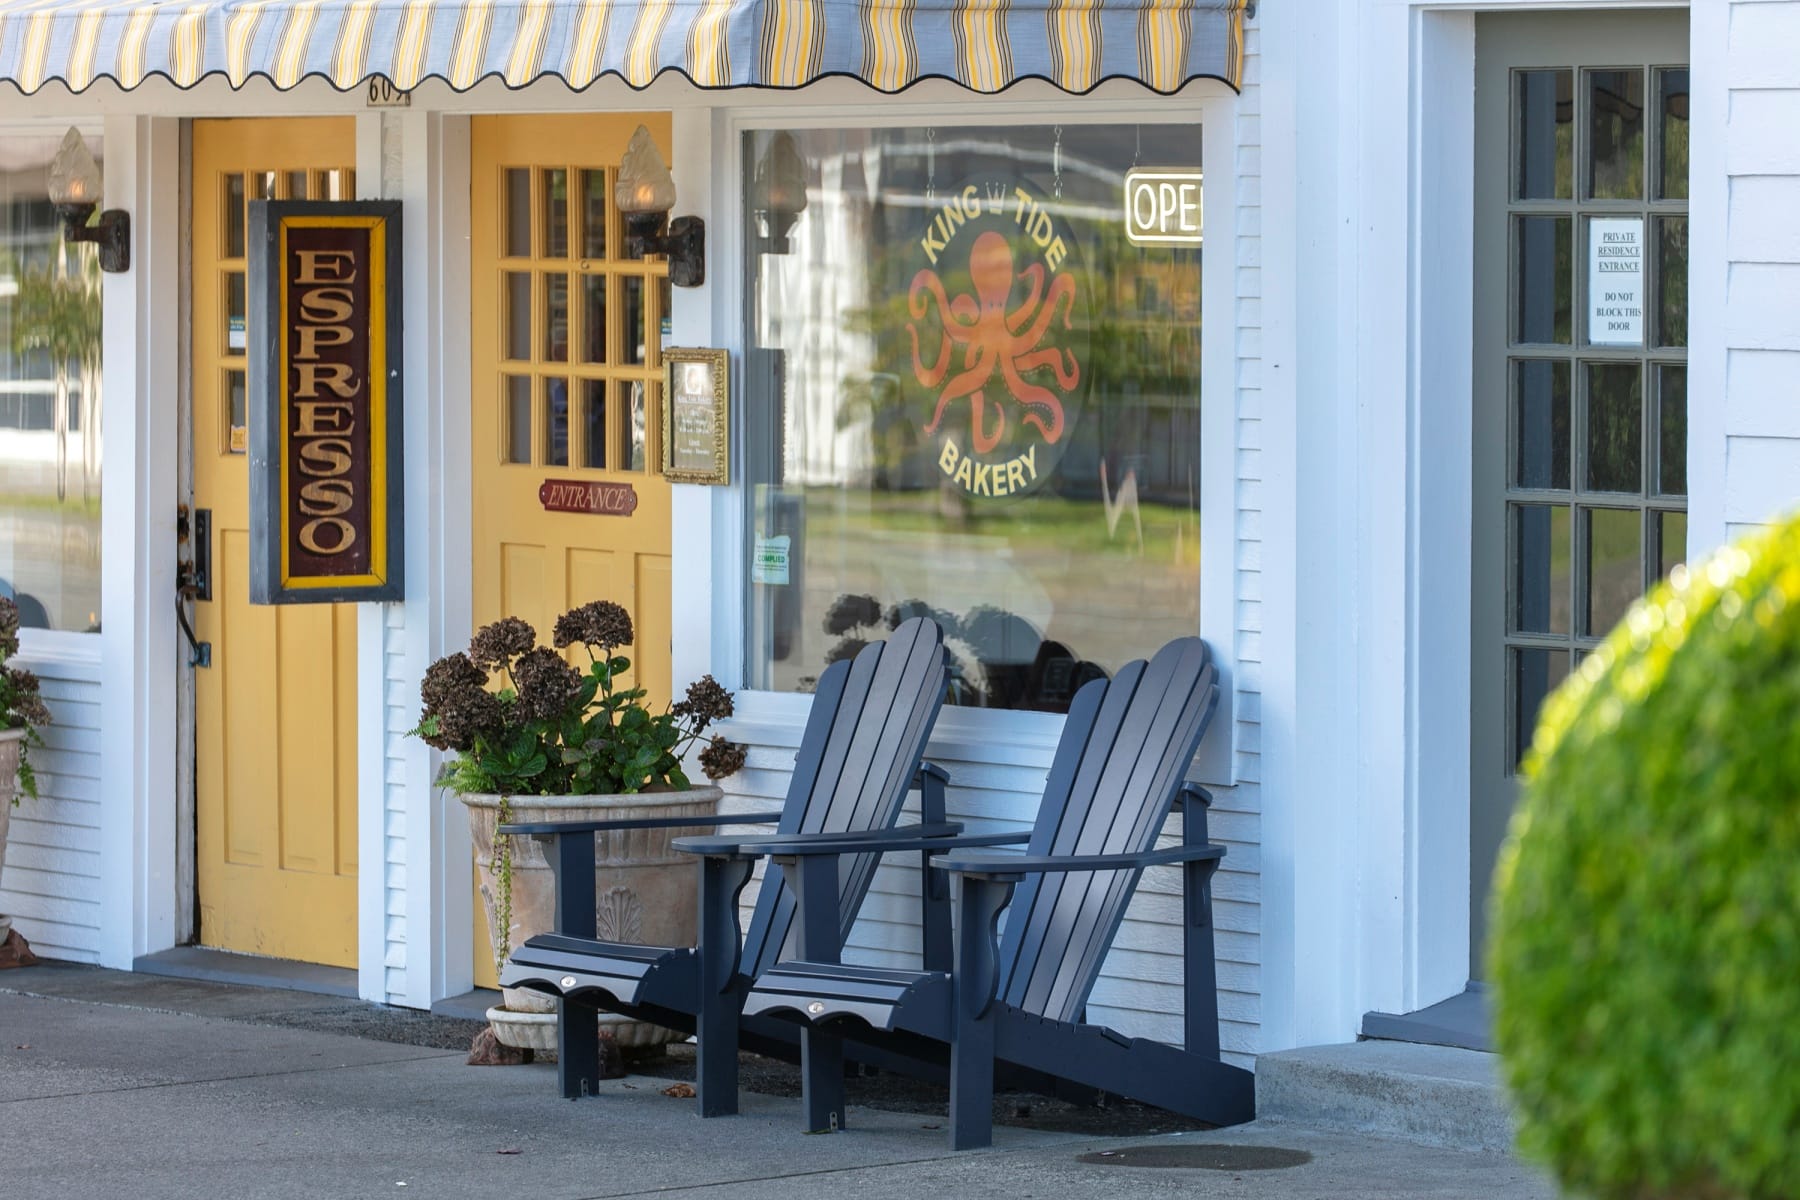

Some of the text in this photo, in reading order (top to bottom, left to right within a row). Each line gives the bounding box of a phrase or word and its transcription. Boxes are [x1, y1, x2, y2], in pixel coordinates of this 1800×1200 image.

[1133, 182, 1203, 233] OPE
[921, 185, 1068, 272] KING TIDE
[1603, 232, 1636, 242] PRIVATE
[1598, 246, 1640, 256] RESIDENCE
[1599, 262, 1640, 271] ENTRANCE
[1605, 292, 1634, 302] DO NOT
[1596, 307, 1642, 317] BLOCK THIS
[1608, 321, 1630, 331] DOOR
[293, 250, 361, 554] ESPRESSO
[938, 439, 1037, 497] BAKERY
[547, 484, 627, 511] ENTRANCE
[757, 555, 785, 563] COMPLIED
